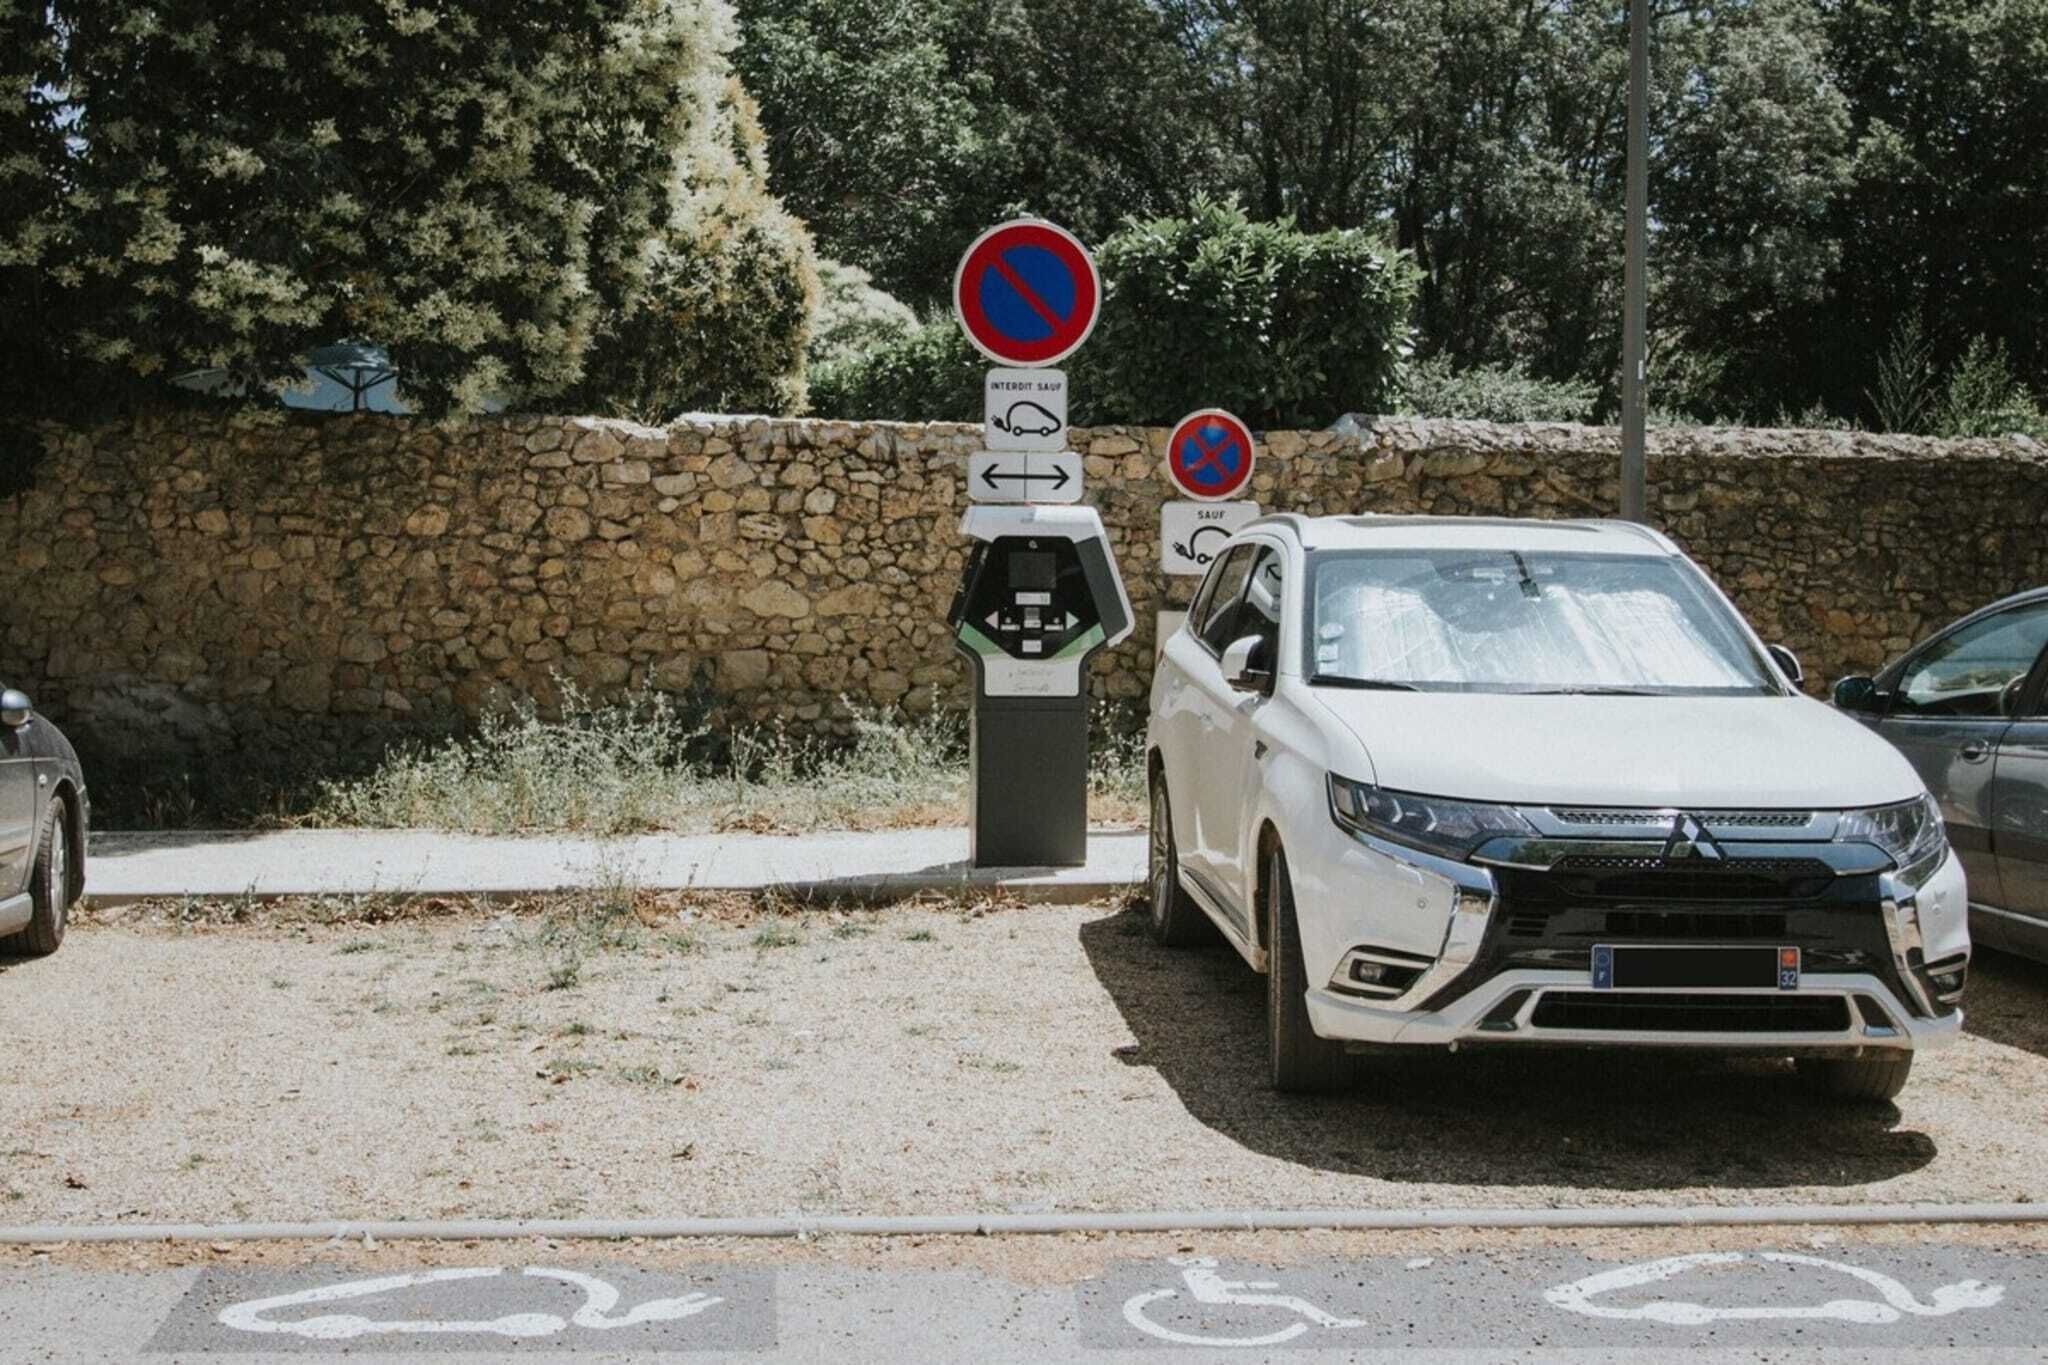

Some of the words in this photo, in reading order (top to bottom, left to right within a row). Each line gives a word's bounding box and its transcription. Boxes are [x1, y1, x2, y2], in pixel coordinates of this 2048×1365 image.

[991, 382, 1032, 391] INTERDIT
[1037, 382, 1062, 391] SAUF
[1197, 510, 1226, 520] SAUF
[1780, 971, 1797, 987] 32
